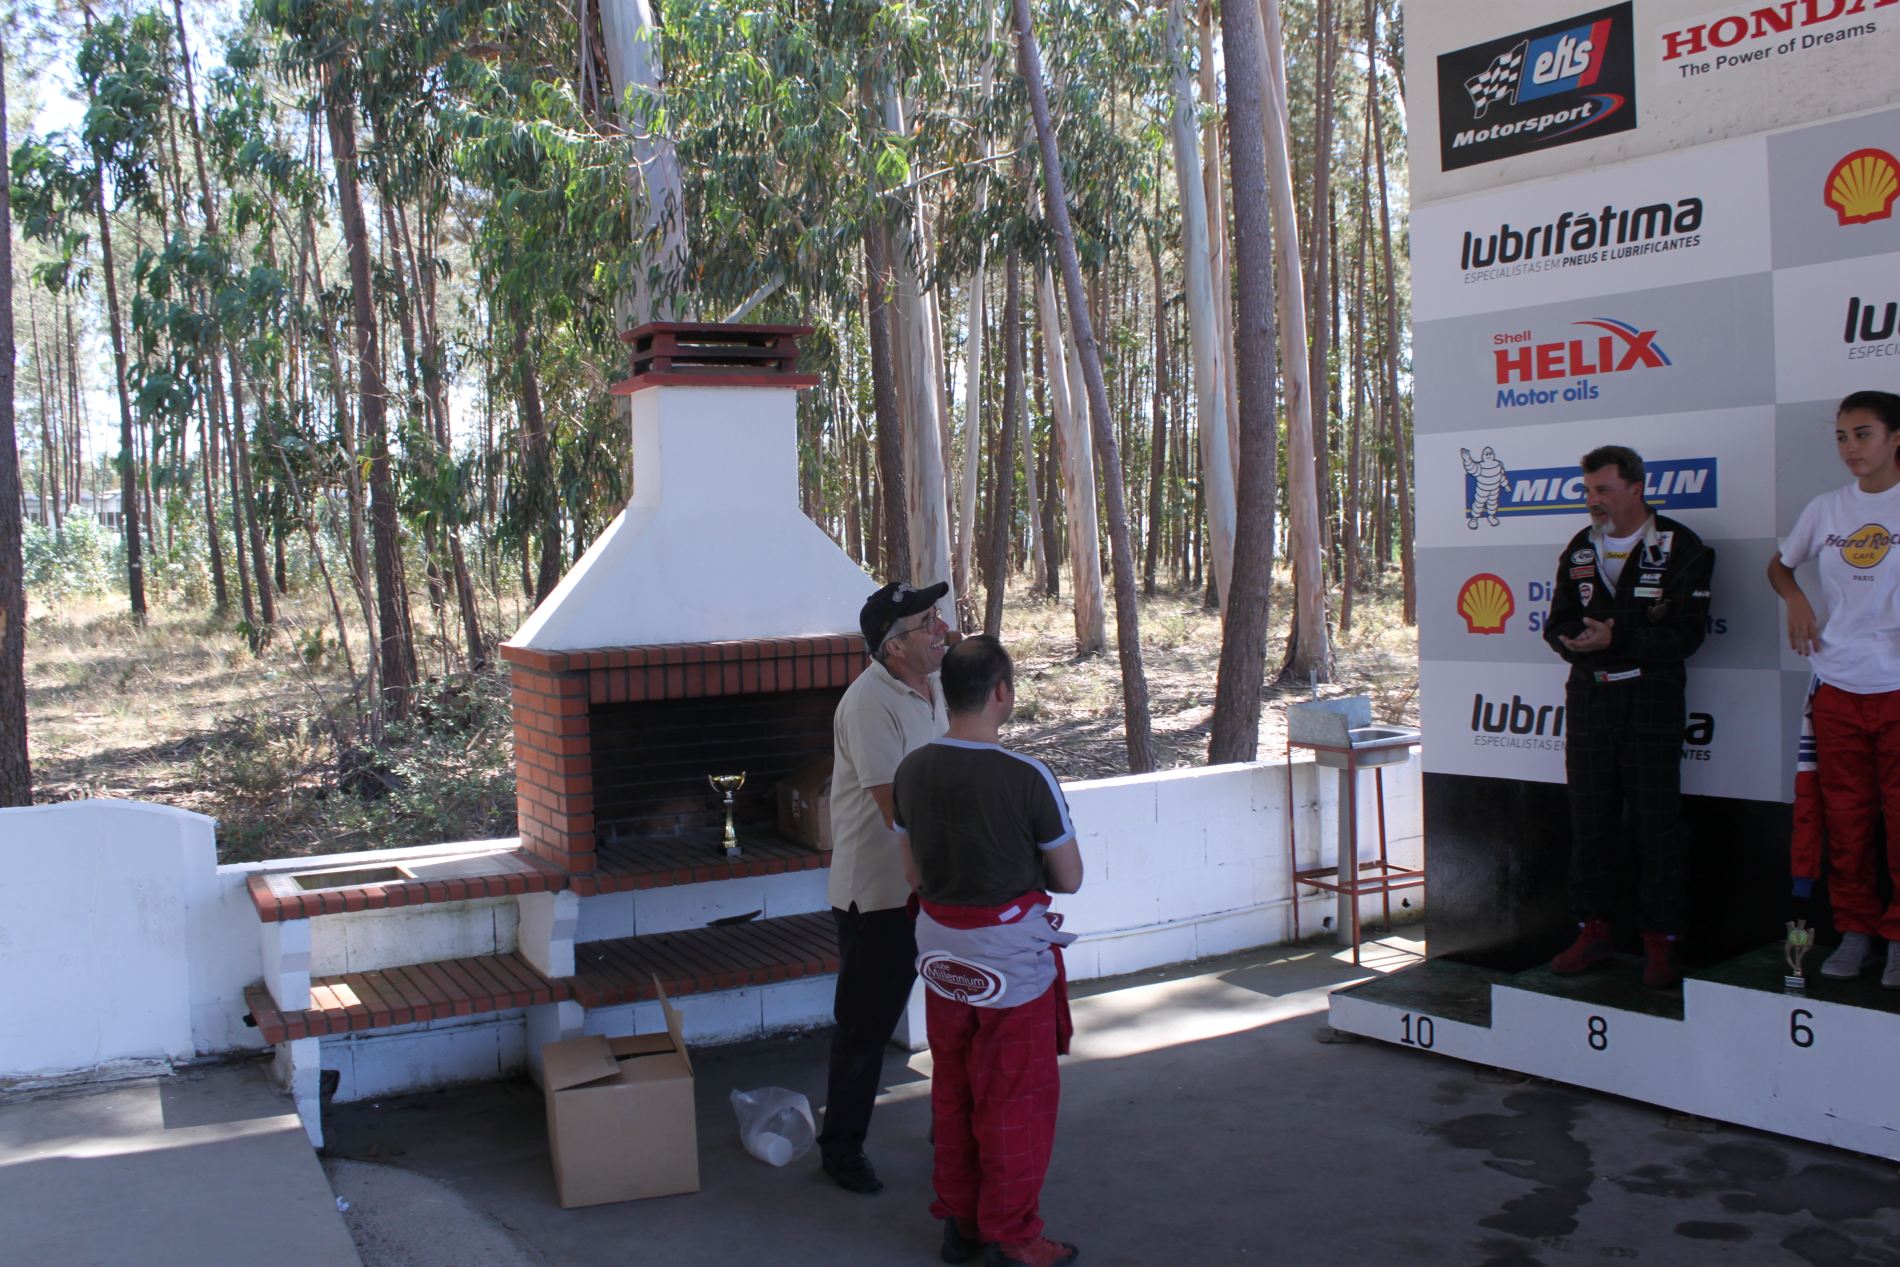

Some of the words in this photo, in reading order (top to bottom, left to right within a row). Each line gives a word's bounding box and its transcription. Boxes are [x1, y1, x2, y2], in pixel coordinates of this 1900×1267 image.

[1679, 62, 1711, 78] The
[1716, 47, 1772, 70] Power
[1777, 38, 1797, 55] of
[1802, 22, 1877, 49] Dreams
[1452, 102, 1593, 148] Motorsport
[1461, 197, 1703, 270] lubrifátima
[1464, 262, 1541, 284] ESPECIALISTAS
[1543, 259, 1561, 273] EM
[1562, 250, 1598, 268] PNEUS
[1601, 250, 1608, 262] E
[1610, 235, 1701, 260] LUBRIFICANTES
[1493, 330, 1532, 345] Shell
[1493, 322, 1666, 385] HELIX
[1496, 388, 1558, 409] Motor
[1562, 379, 1599, 402] oils
[1511, 468, 1709, 503] MICLIN
[1825, 533, 1870, 549] Hard
[1868, 532, 1900, 550] Roc
[1474, 735, 1552, 751] ESPECIALISTAS
[927, 967, 985, 987] Millennium
[1401, 1013, 1434, 1048] 10
[1588, 1015, 1608, 1051] 8
[1790, 1009, 1815, 1048] 6
